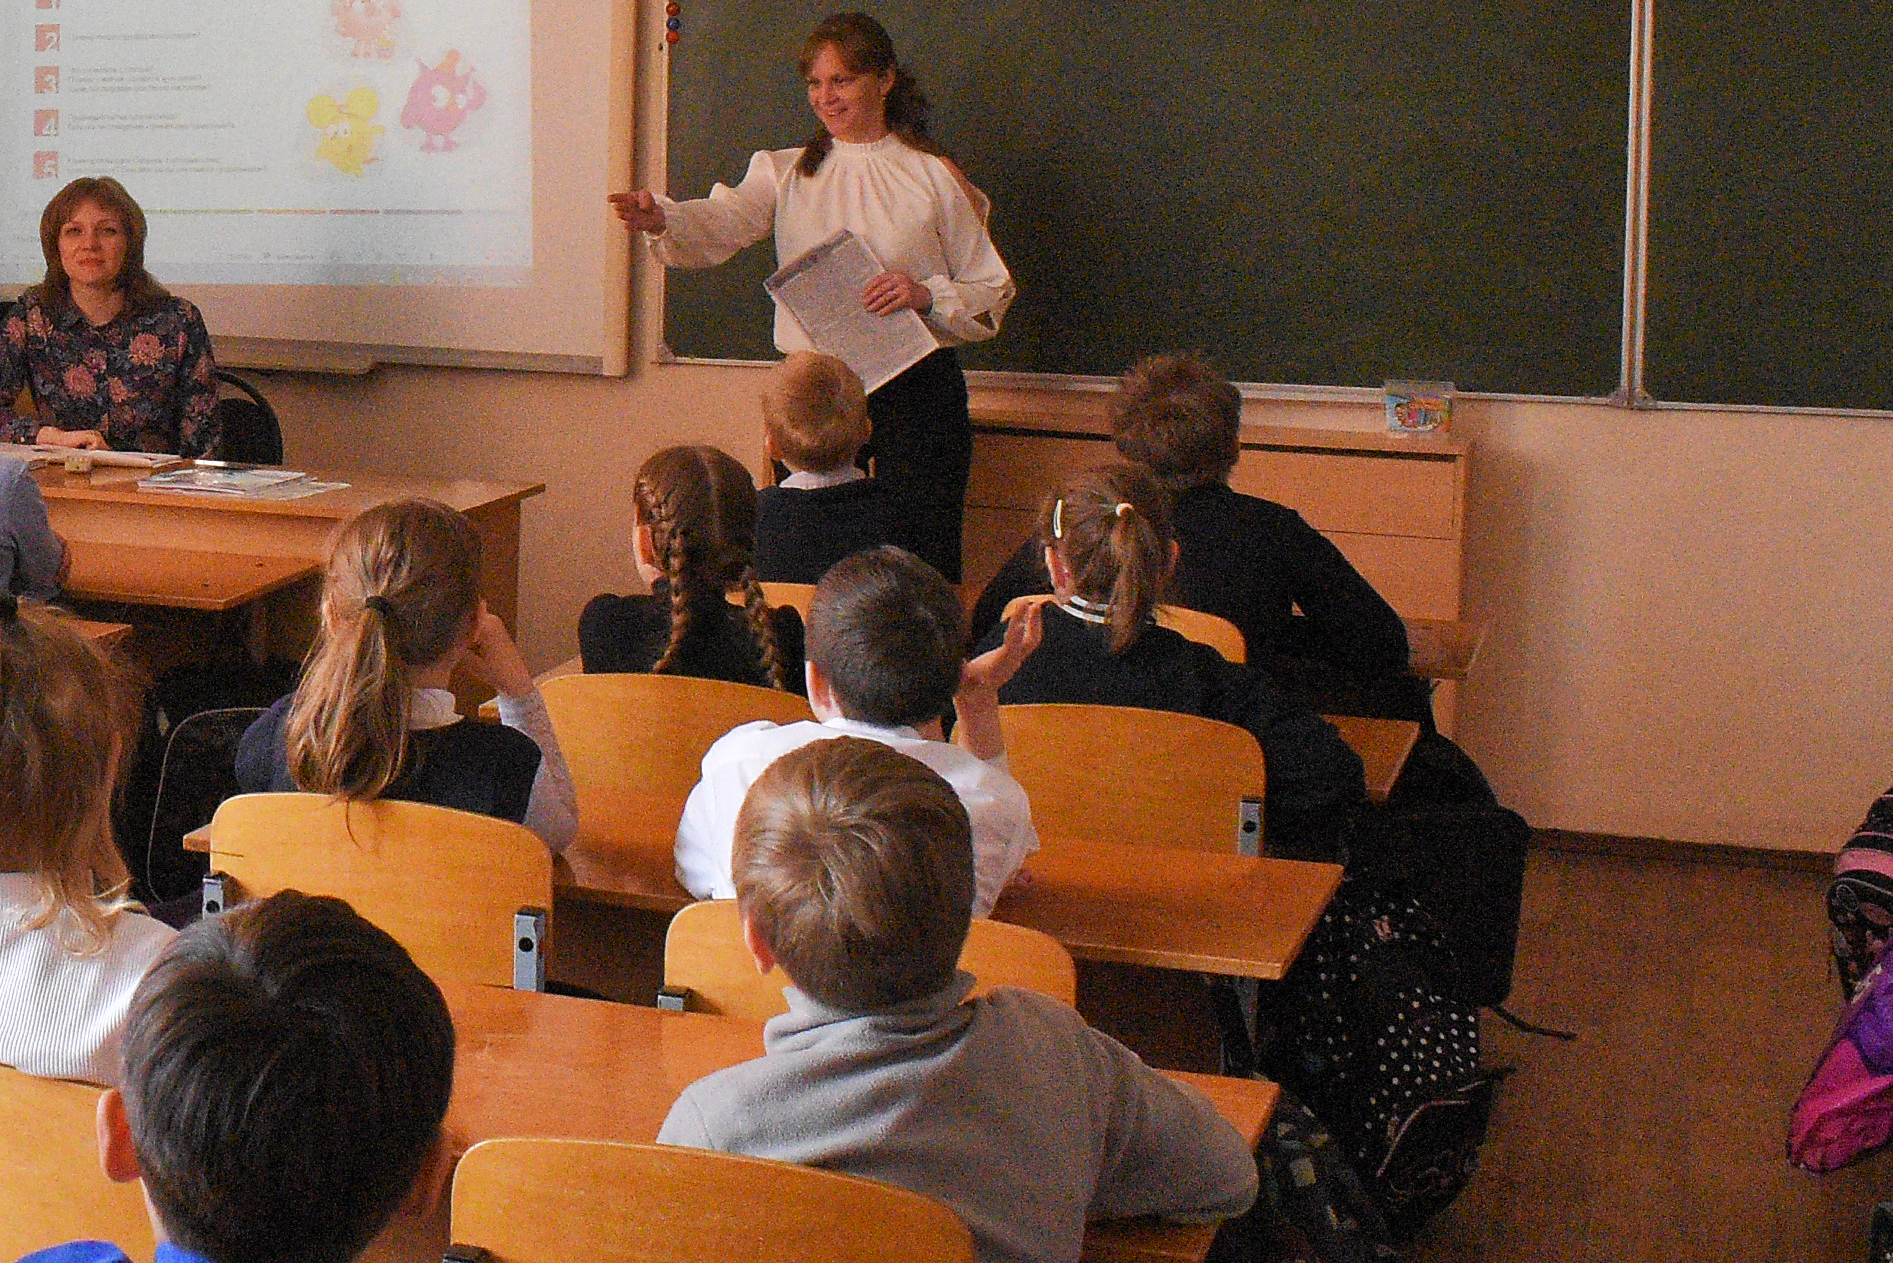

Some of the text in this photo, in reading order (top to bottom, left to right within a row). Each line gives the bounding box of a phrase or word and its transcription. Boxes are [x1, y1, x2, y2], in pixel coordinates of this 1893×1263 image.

[45, 31, 59, 51] 2
[43, 75, 57, 93] 3
[42, 117, 58, 136] 4
[42, 159, 57, 178] 5
